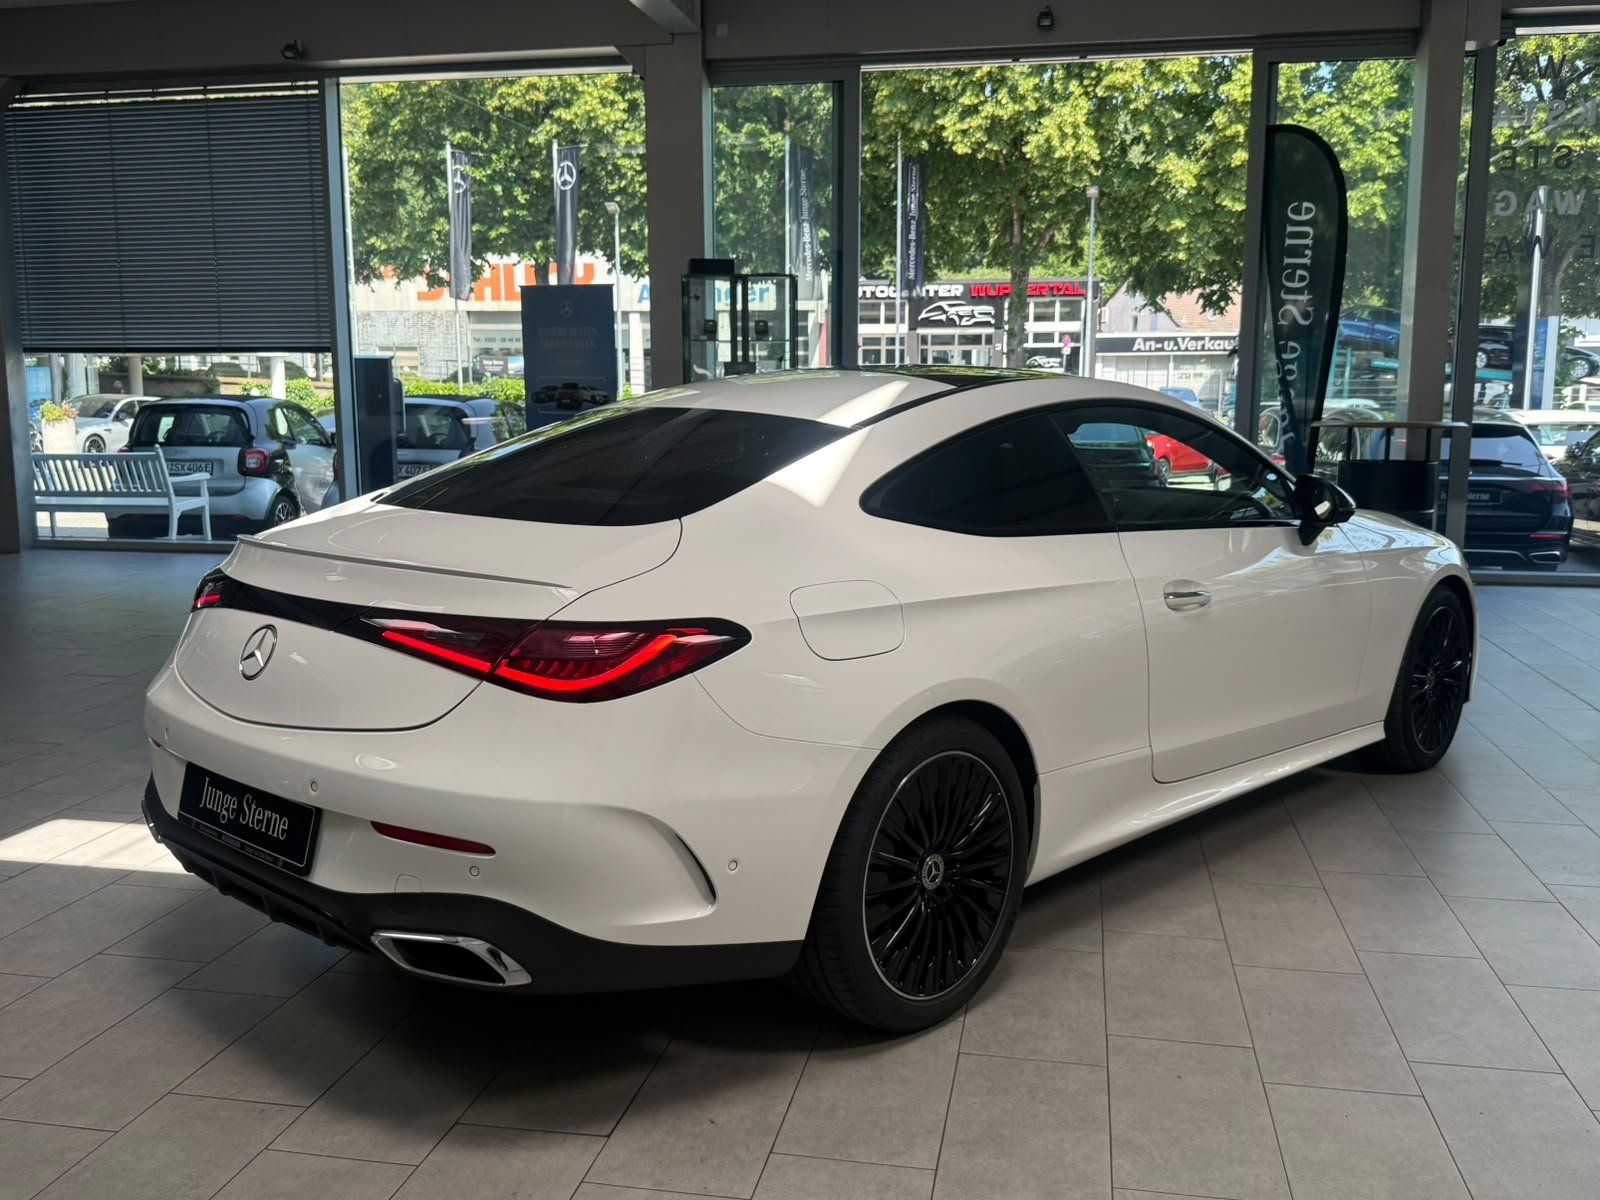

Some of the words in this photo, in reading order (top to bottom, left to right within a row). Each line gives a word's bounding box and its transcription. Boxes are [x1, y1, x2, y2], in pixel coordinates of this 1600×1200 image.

[802, 222, 812, 281] Mercedes-Benz
[908, 220, 916, 280] Mercedes-Benz
[971, 284, 1086, 297] WUPERTAL
[199, 776, 238, 824] Junge
[239, 793, 289, 841] Sterne
